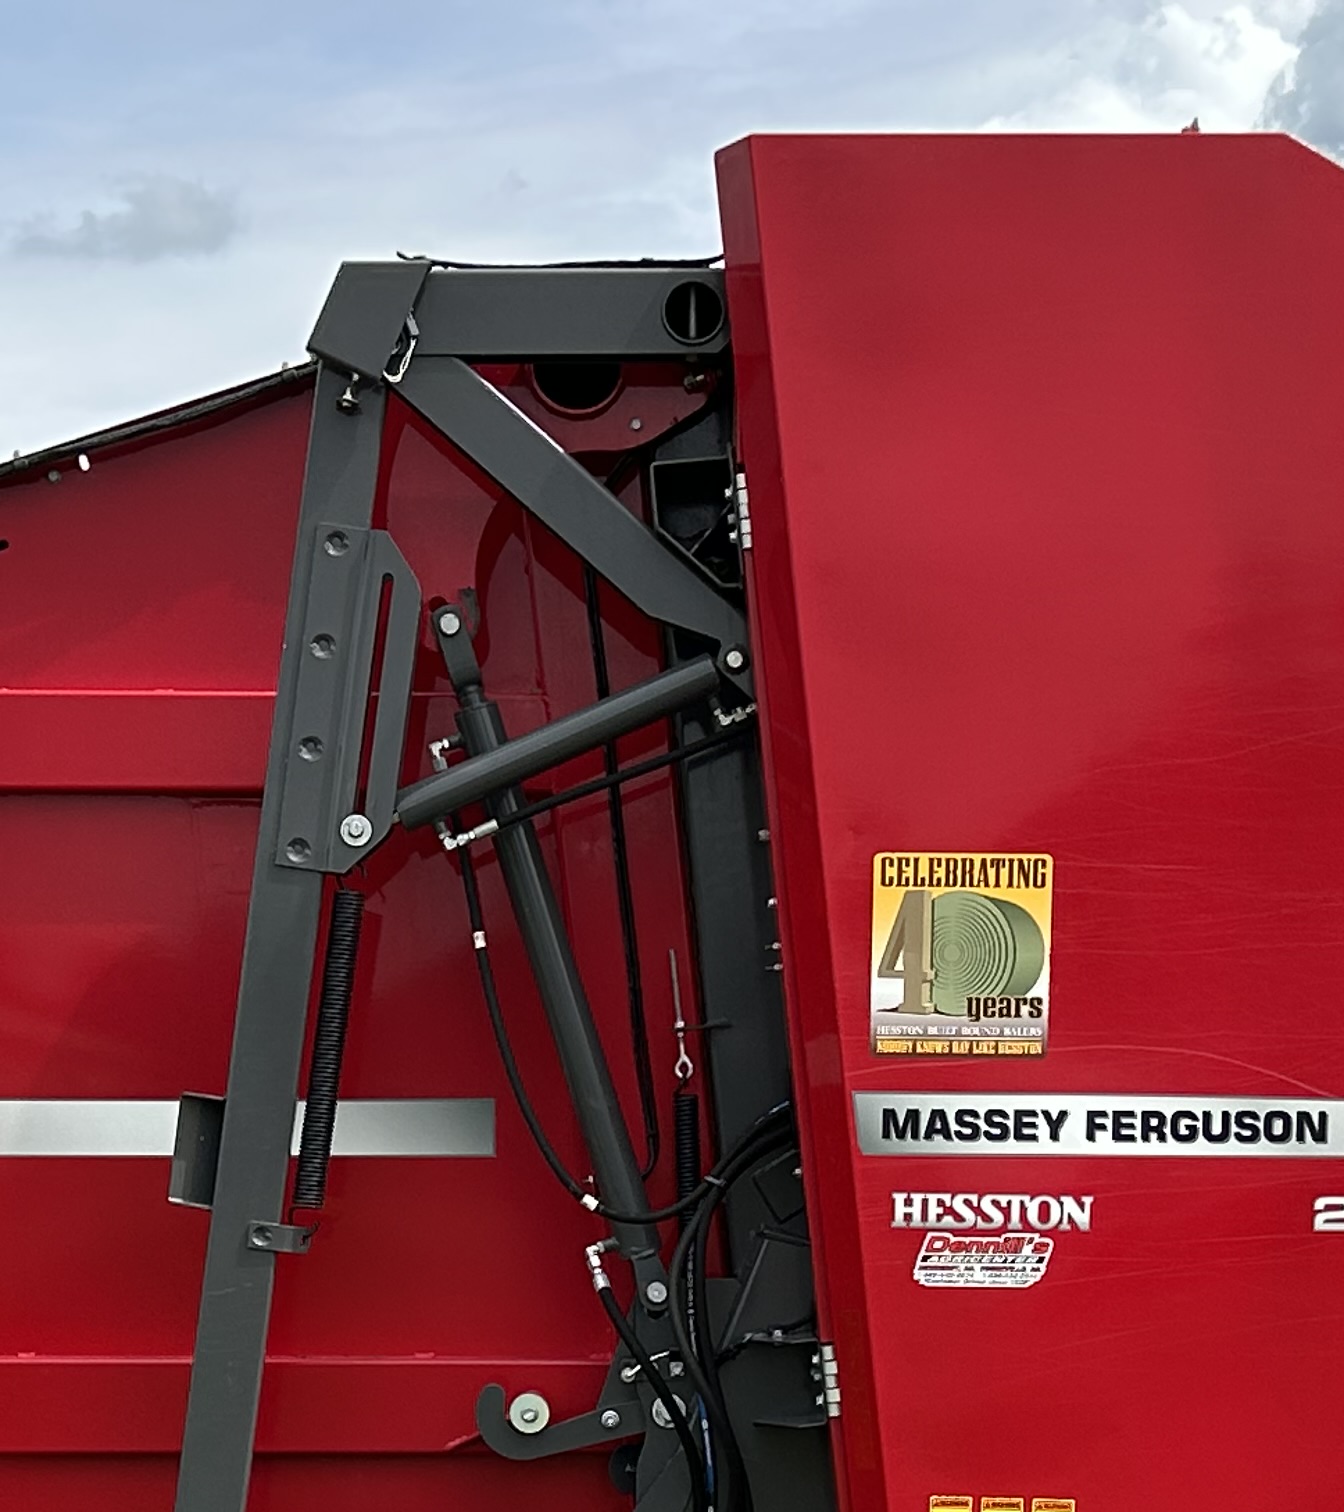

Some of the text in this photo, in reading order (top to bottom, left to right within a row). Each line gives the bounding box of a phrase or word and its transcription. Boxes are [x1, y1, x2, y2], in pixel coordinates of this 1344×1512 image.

[880, 856, 1048, 889] CELEBRATING
[966, 995, 1044, 1022] years
[876, 1025, 924, 1036] HESSTON
[961, 1026, 1001, 1037] ROUND
[881, 1107, 1329, 1145] MASSEY FERGUSON
[890, 1191, 1095, 1232] HESSTON
